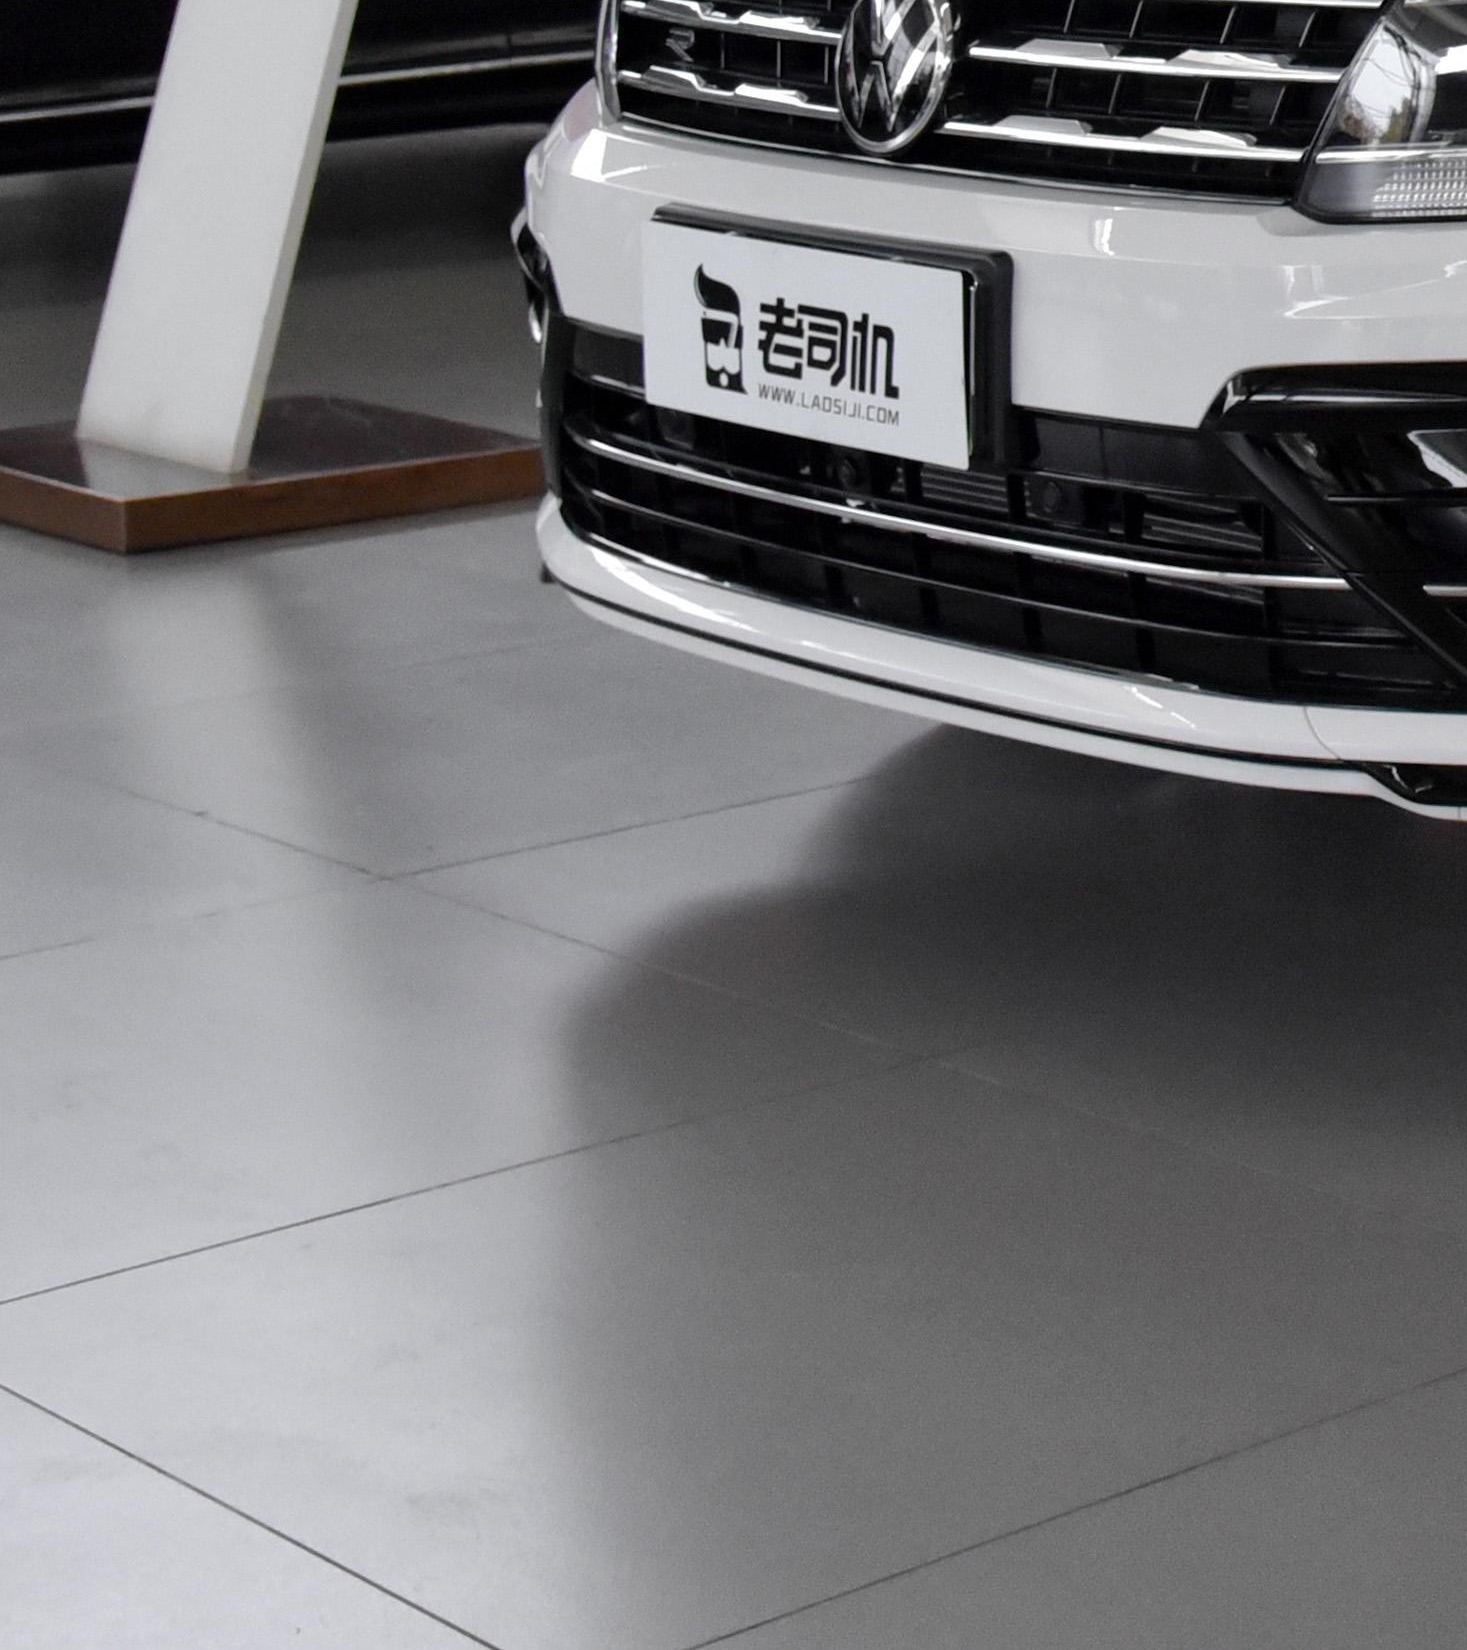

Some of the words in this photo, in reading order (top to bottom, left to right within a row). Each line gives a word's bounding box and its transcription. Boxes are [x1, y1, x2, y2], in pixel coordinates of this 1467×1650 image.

[757, 297, 900, 400] 老司机
[758, 382, 900, 426] WWW.LAOSIJI.COM
